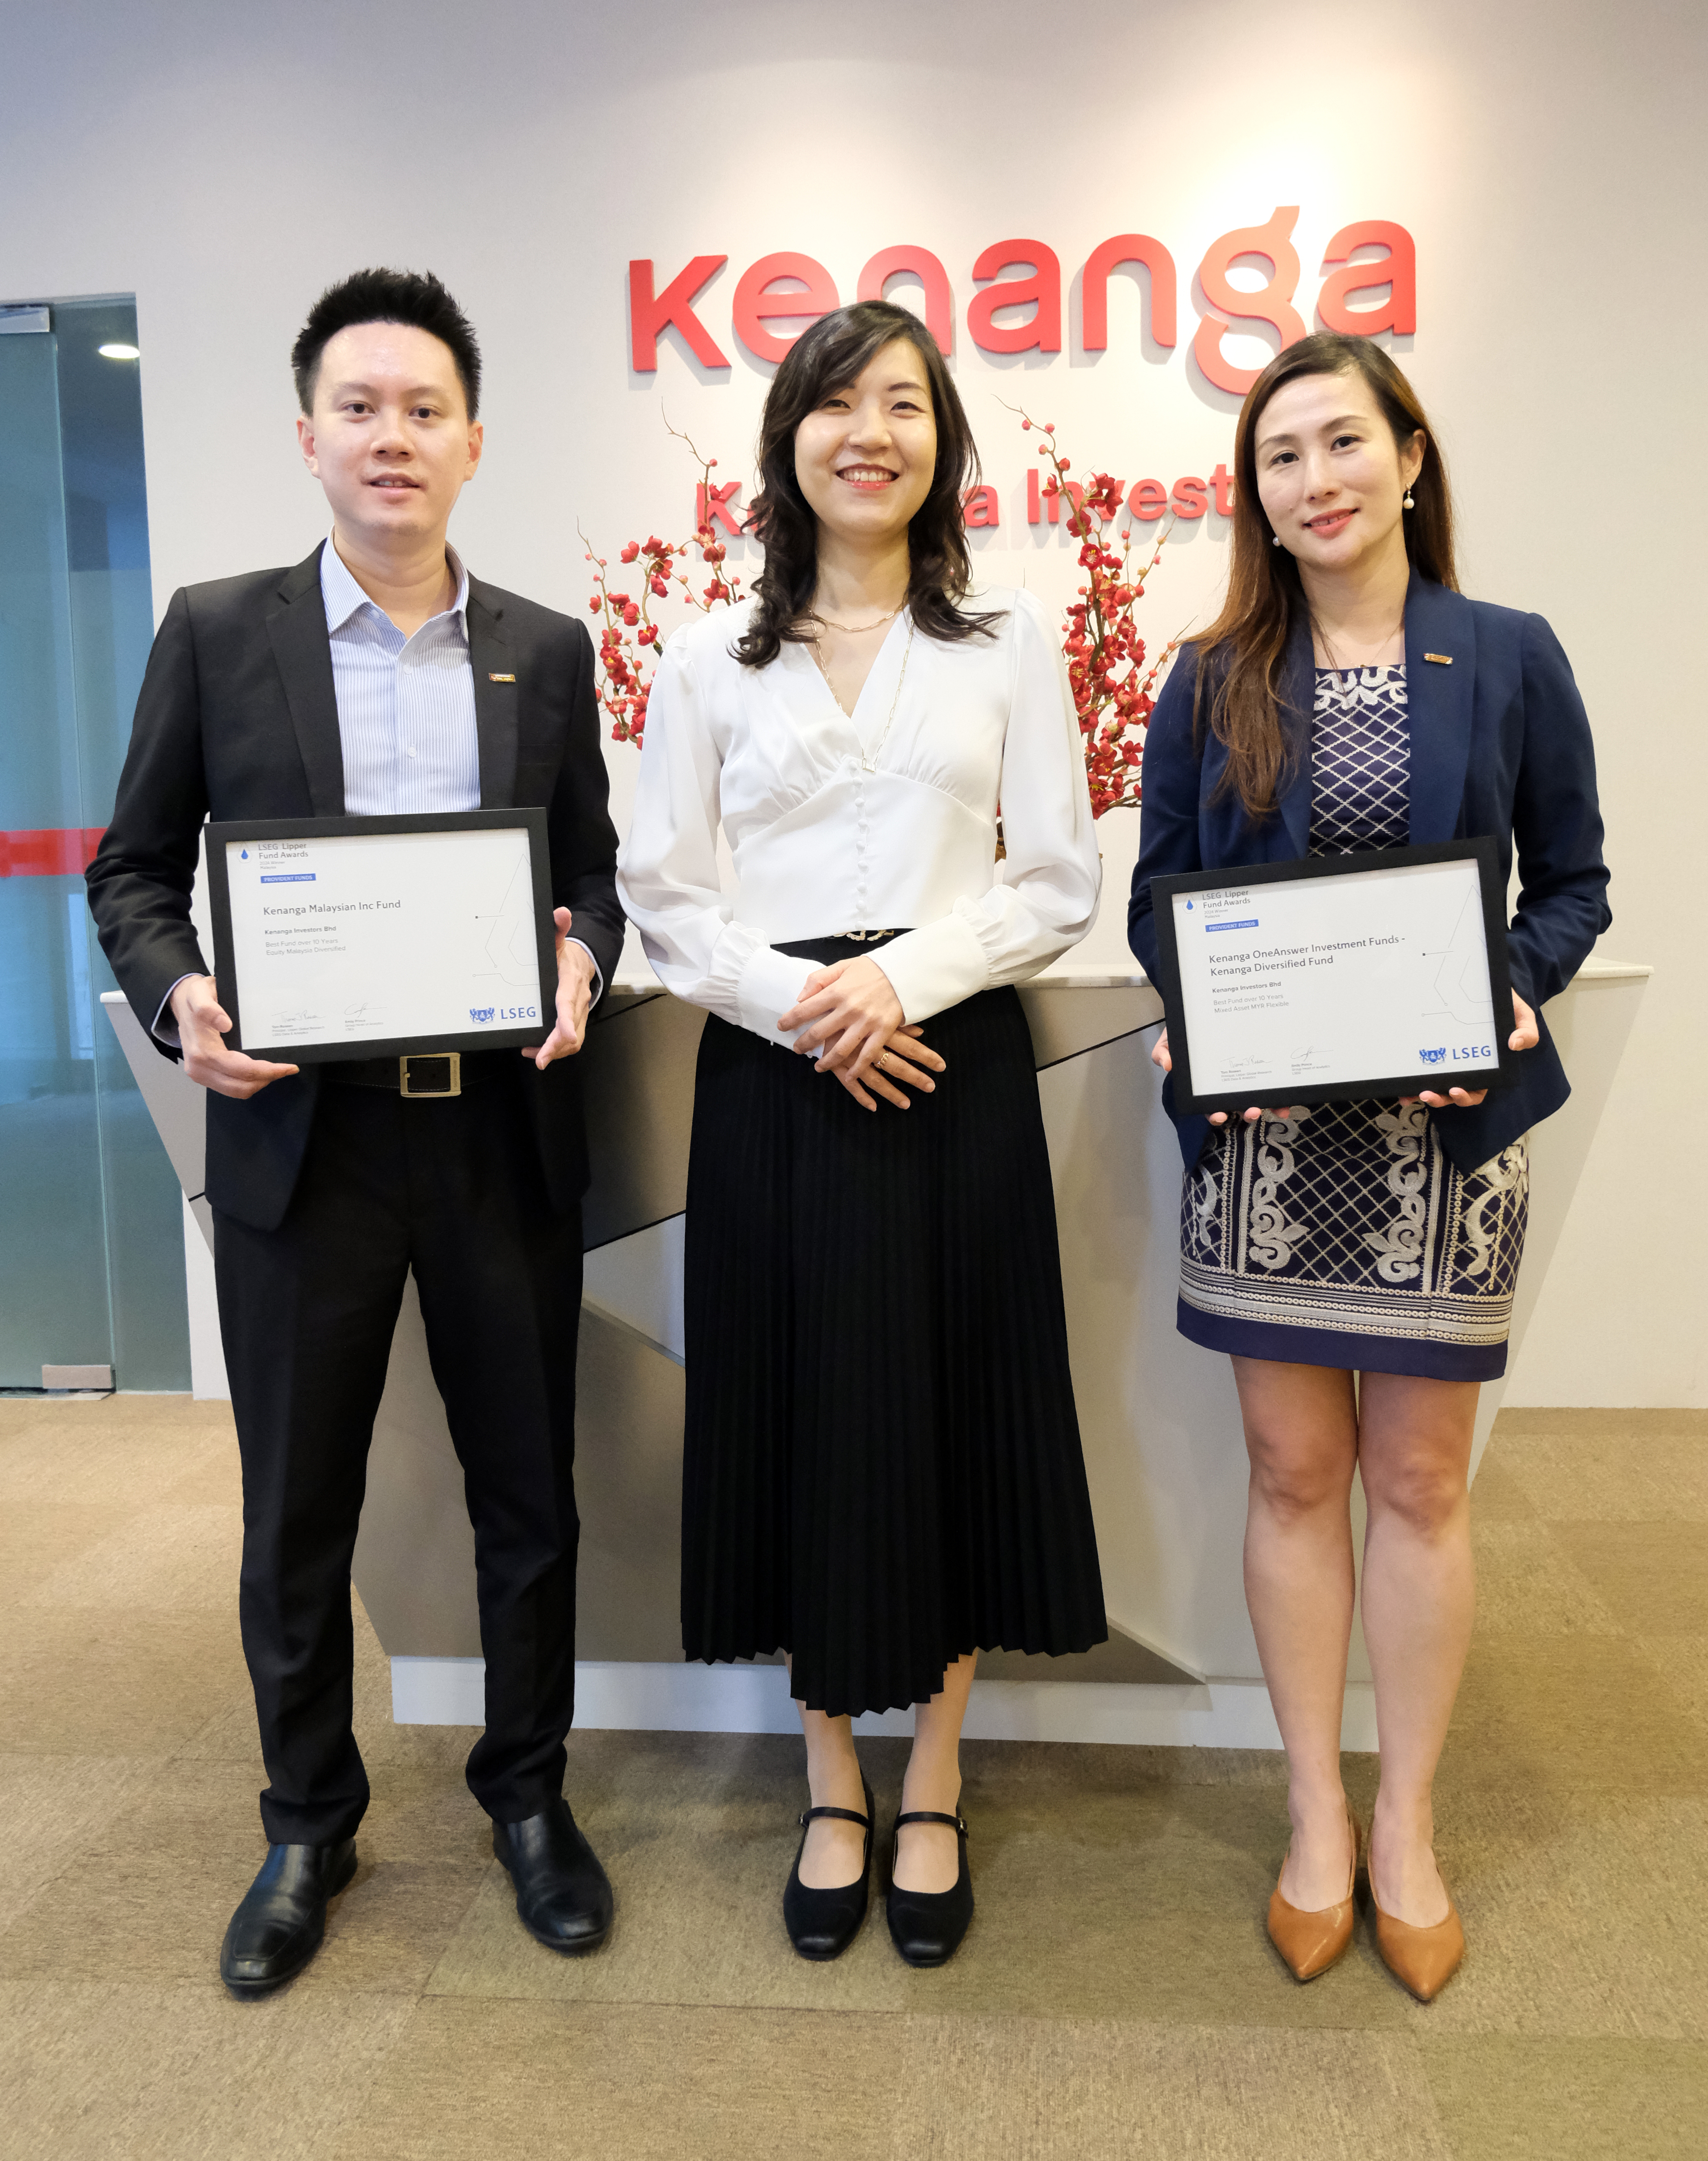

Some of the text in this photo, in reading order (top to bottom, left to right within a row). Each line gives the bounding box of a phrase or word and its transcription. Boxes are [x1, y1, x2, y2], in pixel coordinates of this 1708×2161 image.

[1202, 890, 1249, 900] LSEG Lipper
[263, 900, 401, 916] Kenanga Malaysian Inc Fund
[1203, 898, 1251, 908] Fund Awards
[1209, 953, 1250, 964] Kenanga
[1253, 945, 1309, 959] OneAnswer
[1311, 940, 1366, 952] Investment
[1369, 935, 1399, 946] Funds
[1210, 955, 1334, 976] Kenanga Diversified Fund
[501, 1006, 536, 1019] LSEG
[1452, 1045, 1491, 1059] LSEG
